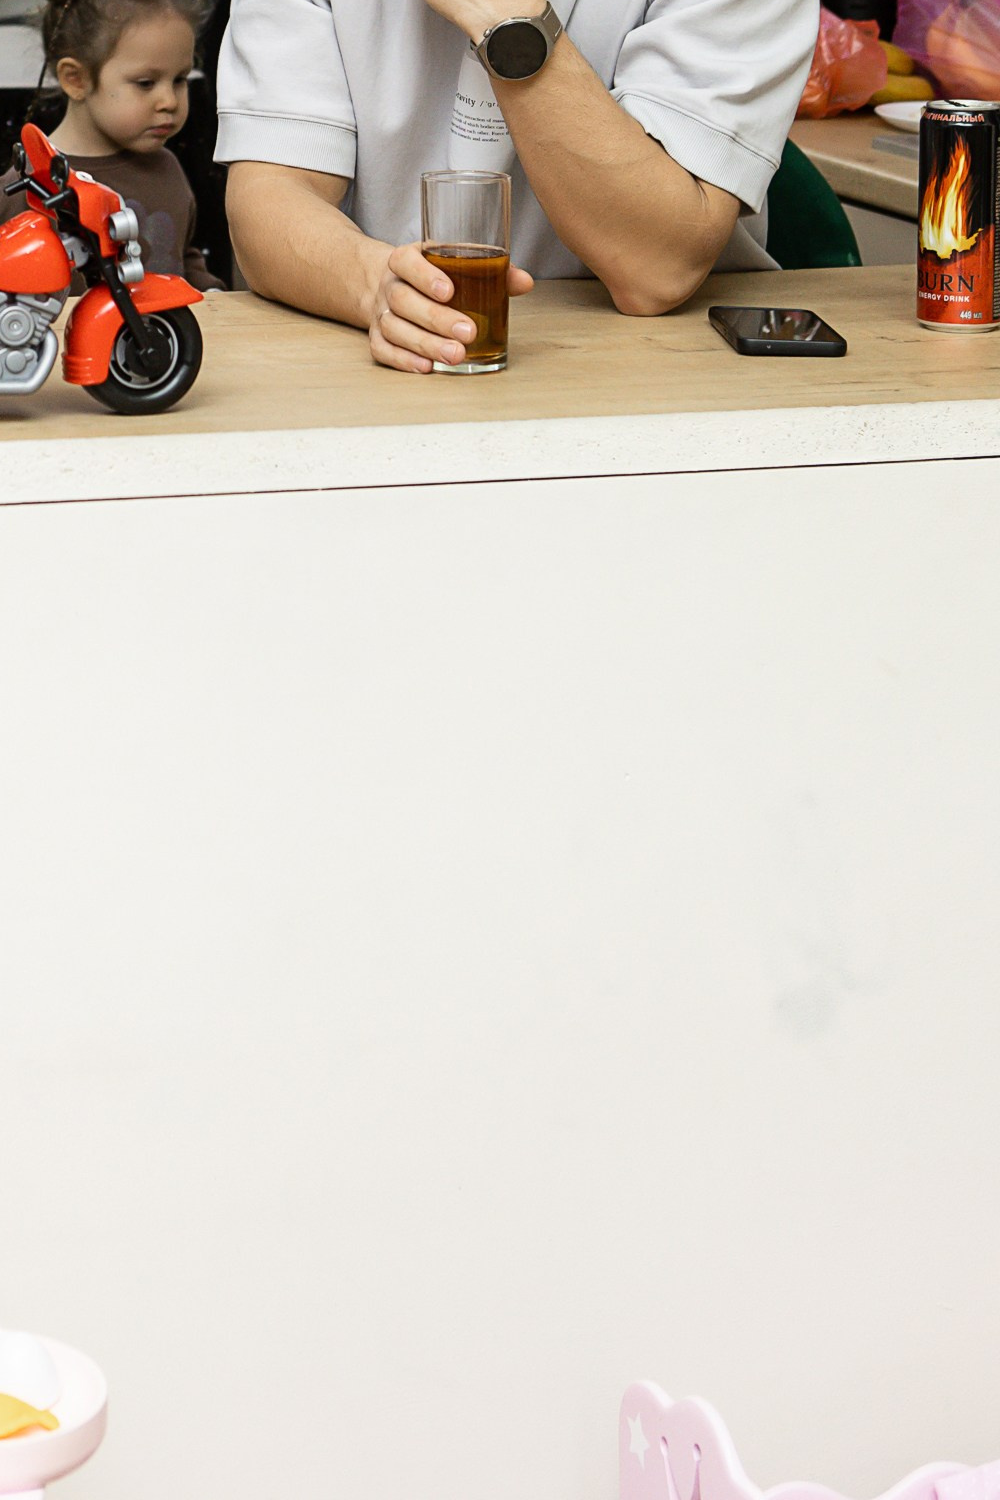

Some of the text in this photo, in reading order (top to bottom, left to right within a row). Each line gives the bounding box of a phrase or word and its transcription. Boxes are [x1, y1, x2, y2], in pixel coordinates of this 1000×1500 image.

[917, 269, 975, 292] BURN
[918, 290, 970, 302] ENERGY DRINK
[959, 310, 972, 319] 449
